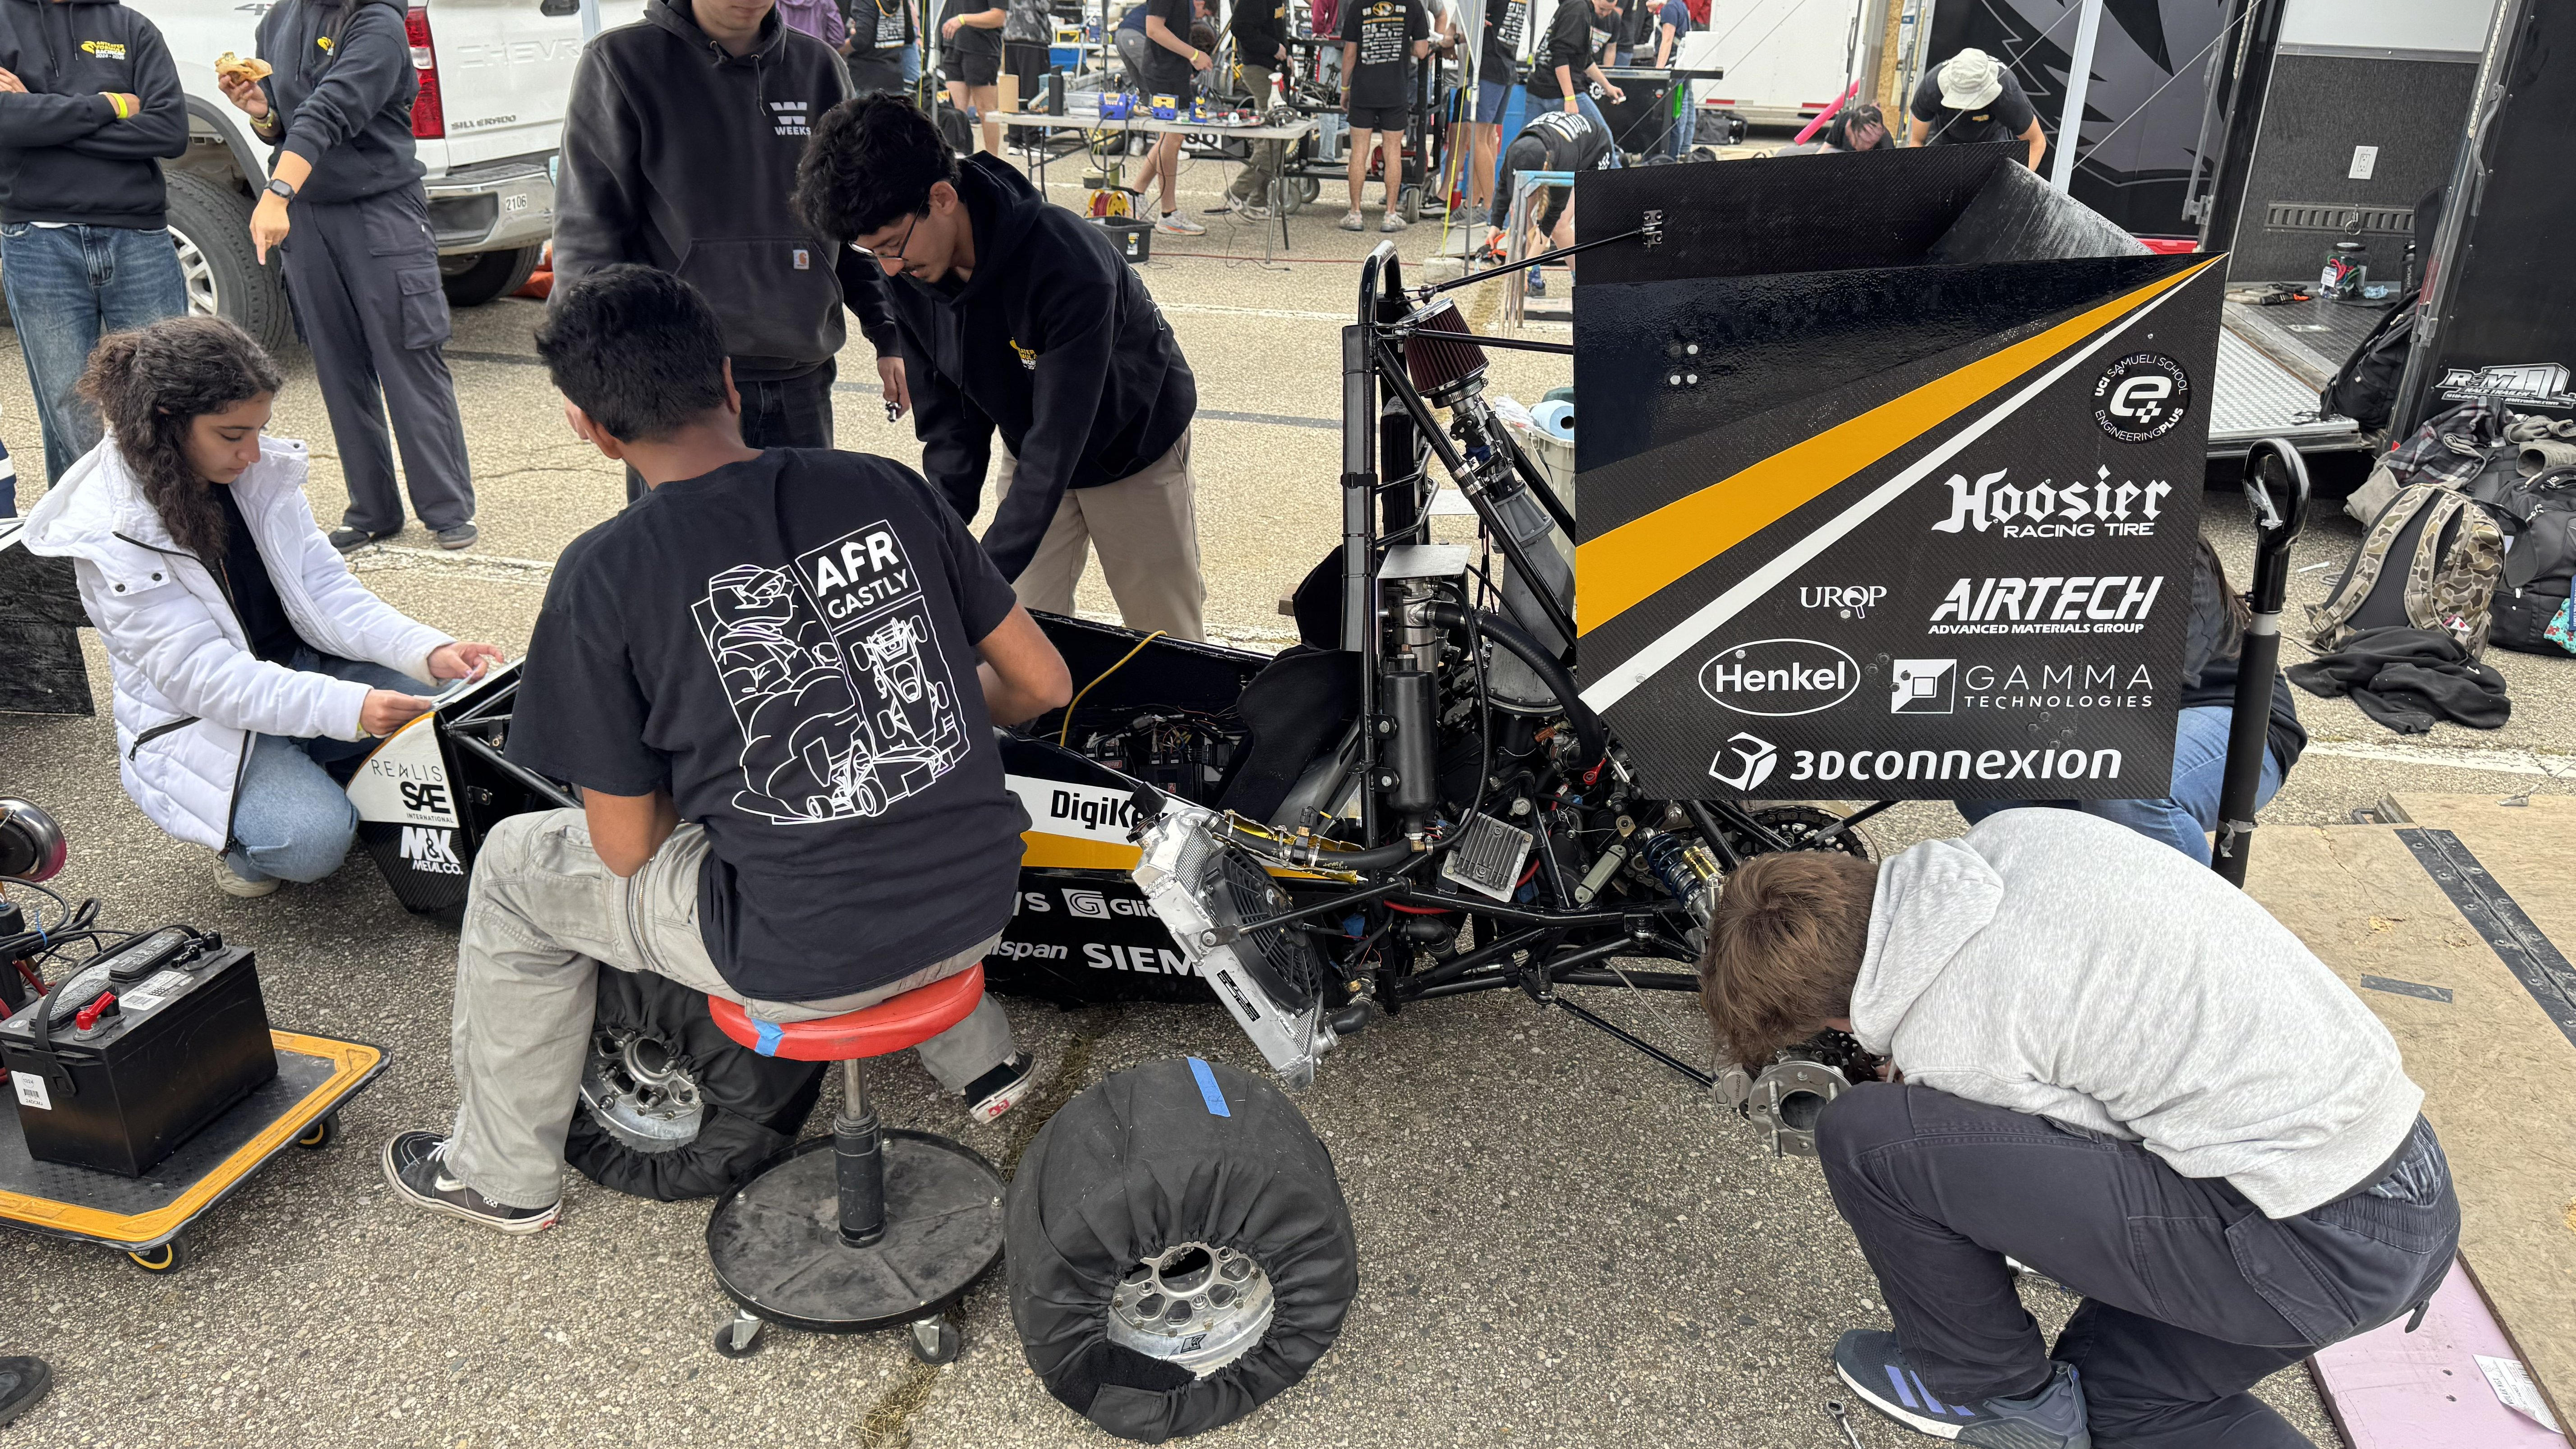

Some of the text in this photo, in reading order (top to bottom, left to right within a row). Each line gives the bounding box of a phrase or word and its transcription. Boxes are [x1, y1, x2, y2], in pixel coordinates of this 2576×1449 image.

[234, 4, 273, 15] 4
[451, 115, 516, 129] SILVERADO
[774, 126, 811, 135] WEEKS
[506, 195, 526, 211] 2106
[2095, 354, 2188, 396] UCI SAMUELI SCHOOL
[1931, 465, 2172, 532] Hoosier
[2004, 522, 2155, 538] RACING TIRE
[818, 531, 899, 598] AFR
[828, 569, 909, 619] GASTLY
[1799, 586, 1887, 619] UROP
[1929, 576, 2164, 621] AIRTECH
[1928, 623, 2144, 635] ADVANCED MATERIALS GROUP
[1716, 661, 1845, 692] Henkel
[1966, 664, 2153, 691] GAMMA
[1964, 695, 2153, 710] TECHNOLOGIES
[406, 813, 455, 823] INTERNATIONAL
[1051, 790, 1168, 830] DigiKe
[400, 826, 460, 864] M&K
[991, 936, 1067, 961] lspan
